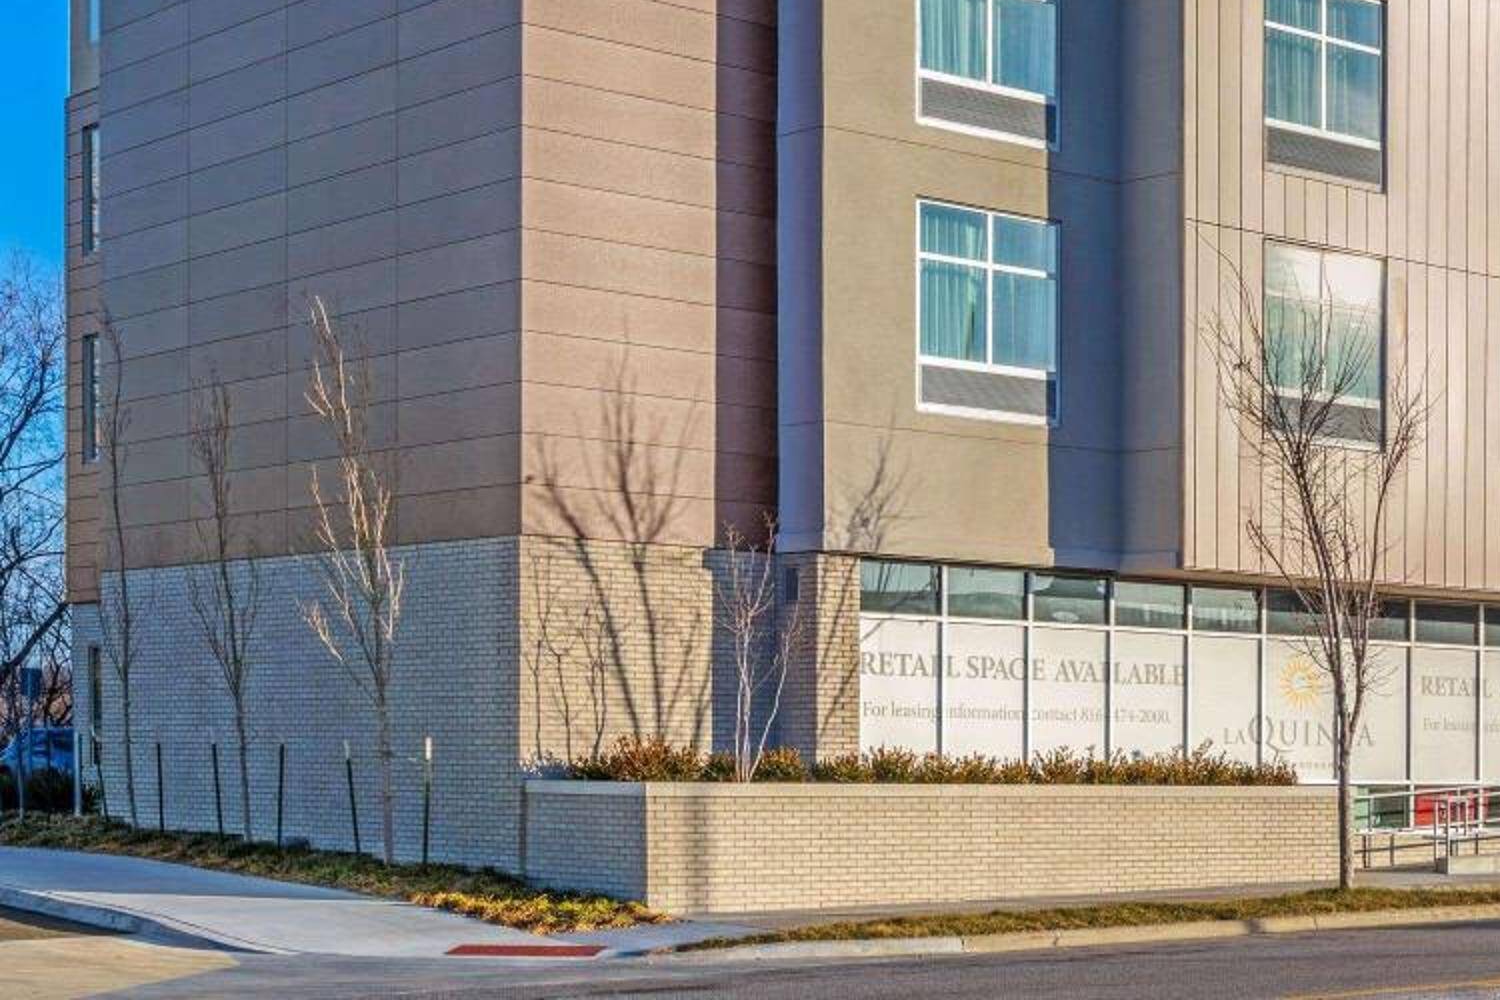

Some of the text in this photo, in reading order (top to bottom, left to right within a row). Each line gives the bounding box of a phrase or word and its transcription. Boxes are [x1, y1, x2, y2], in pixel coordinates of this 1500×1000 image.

[860, 651, 1185, 687] RETAIL SPACE AVAILABLE
[1421, 676, 1494, 698] RETAIL
[863, 701, 887, 718] For
[1224, 715, 1375, 752] LA QUINA
